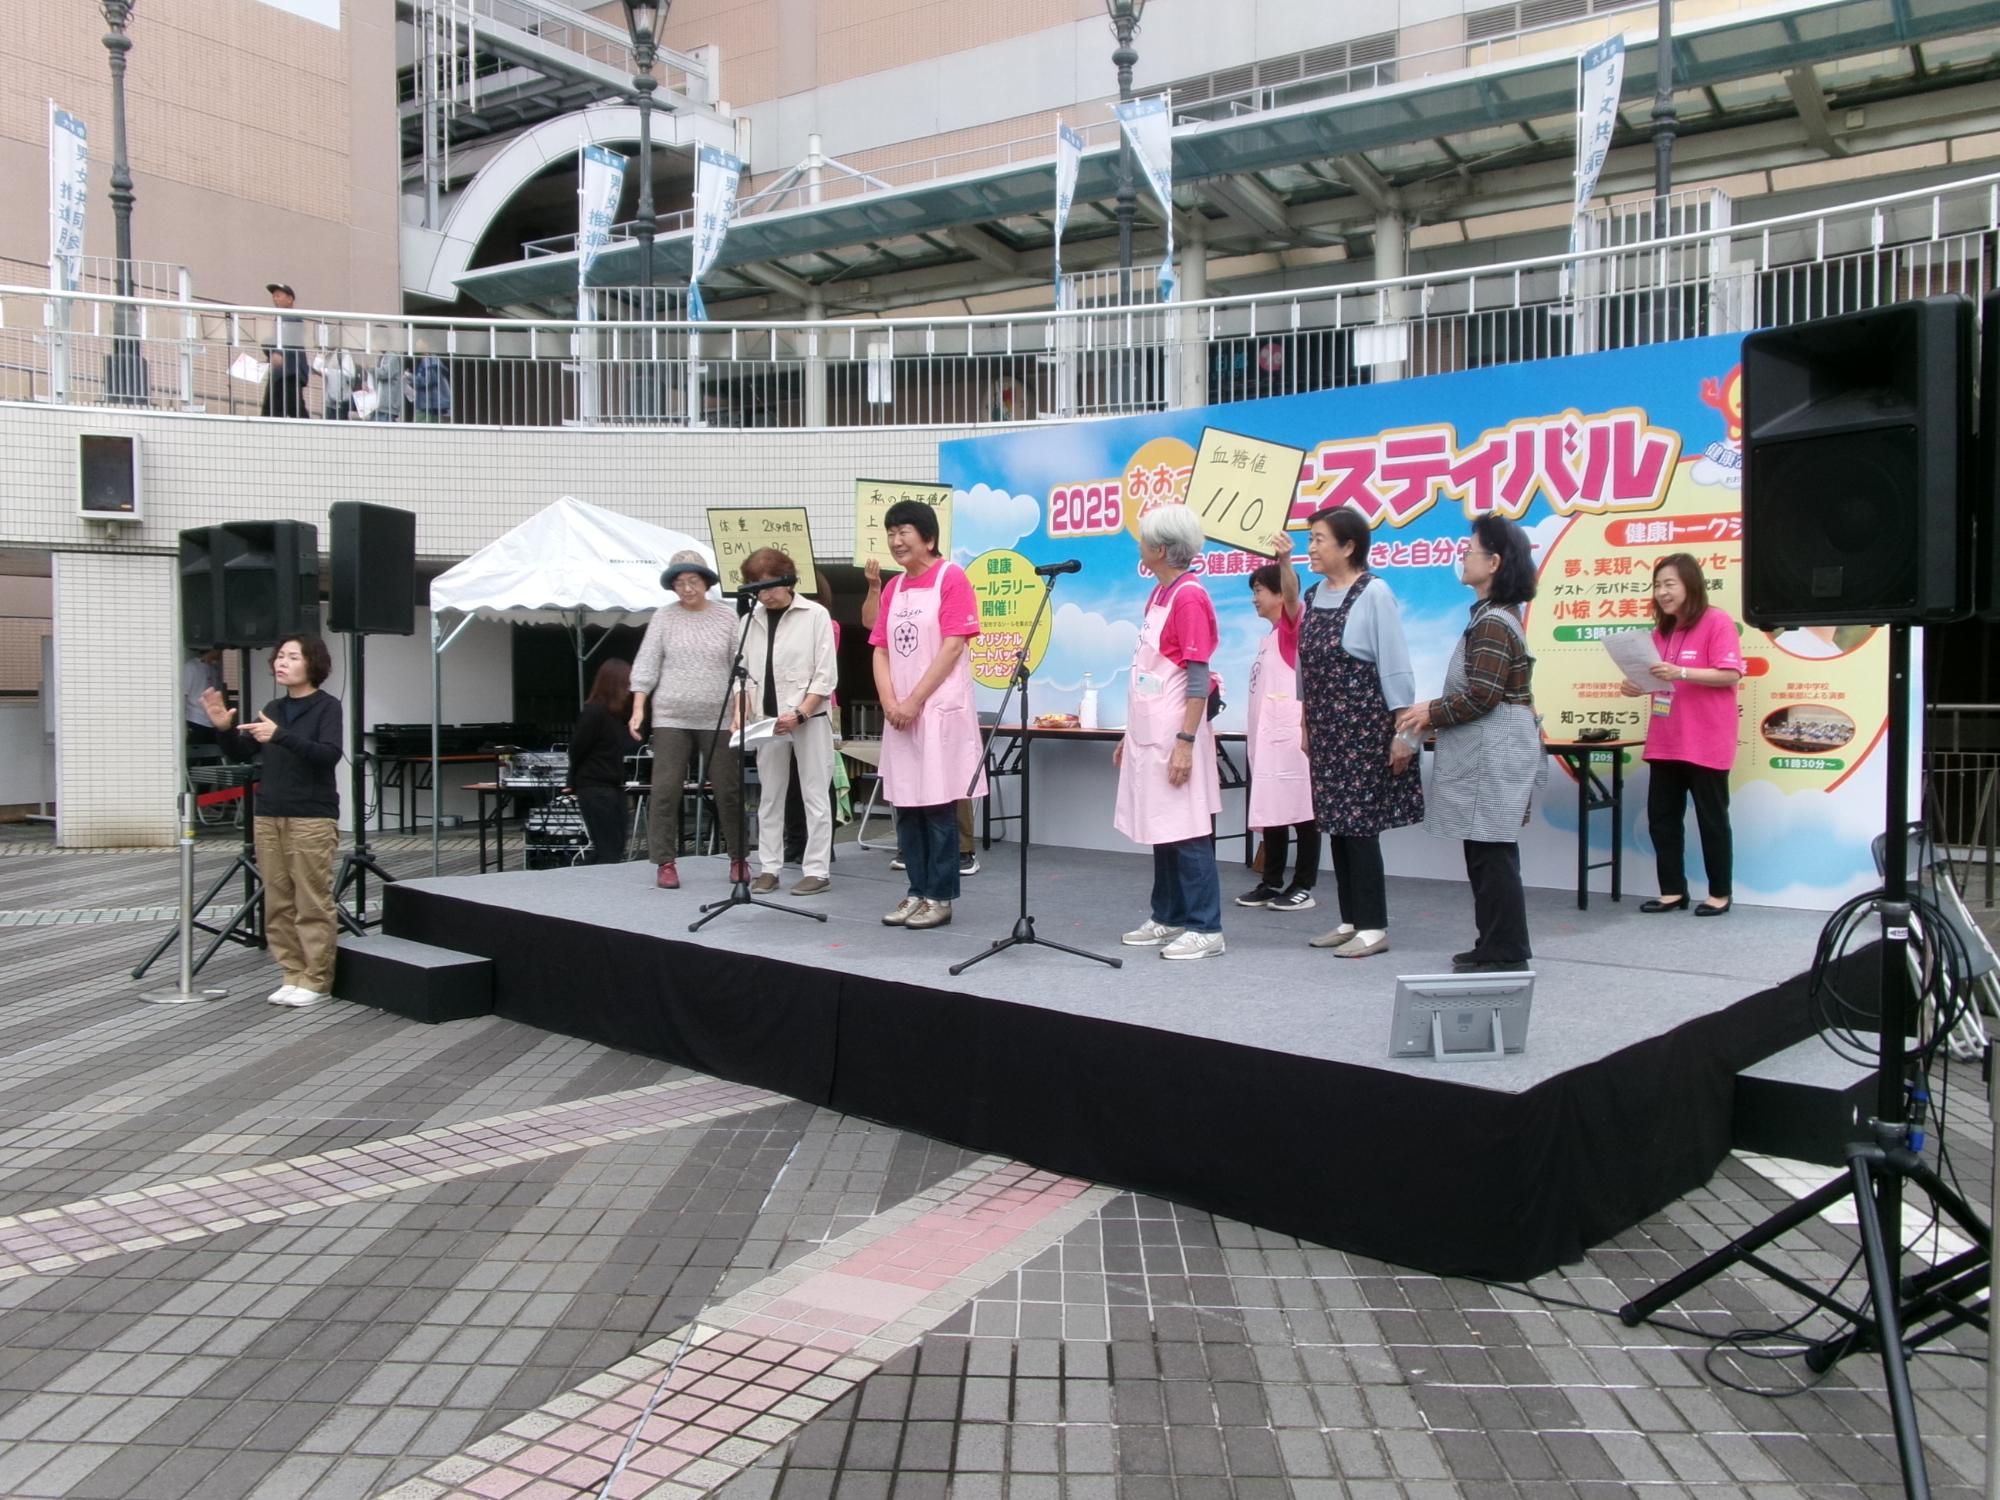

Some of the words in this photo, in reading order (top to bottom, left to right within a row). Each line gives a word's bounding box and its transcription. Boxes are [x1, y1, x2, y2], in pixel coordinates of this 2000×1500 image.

[1210, 445, 1270, 474] 血糖値
[1053, 485, 1120, 531] 2025
[1201, 487, 1264, 532] 110
[866, 514, 878, 528] 上
[987, 558, 1012, 575] 健康
[973, 579, 1036, 596] ールラリー
[1553, 600, 1591, 620] 小椋
[976, 632, 1022, 647] オリジナル
[970, 647, 1030, 661] トートバッグ
[1561, 710, 1640, 725] 知って防ごう
